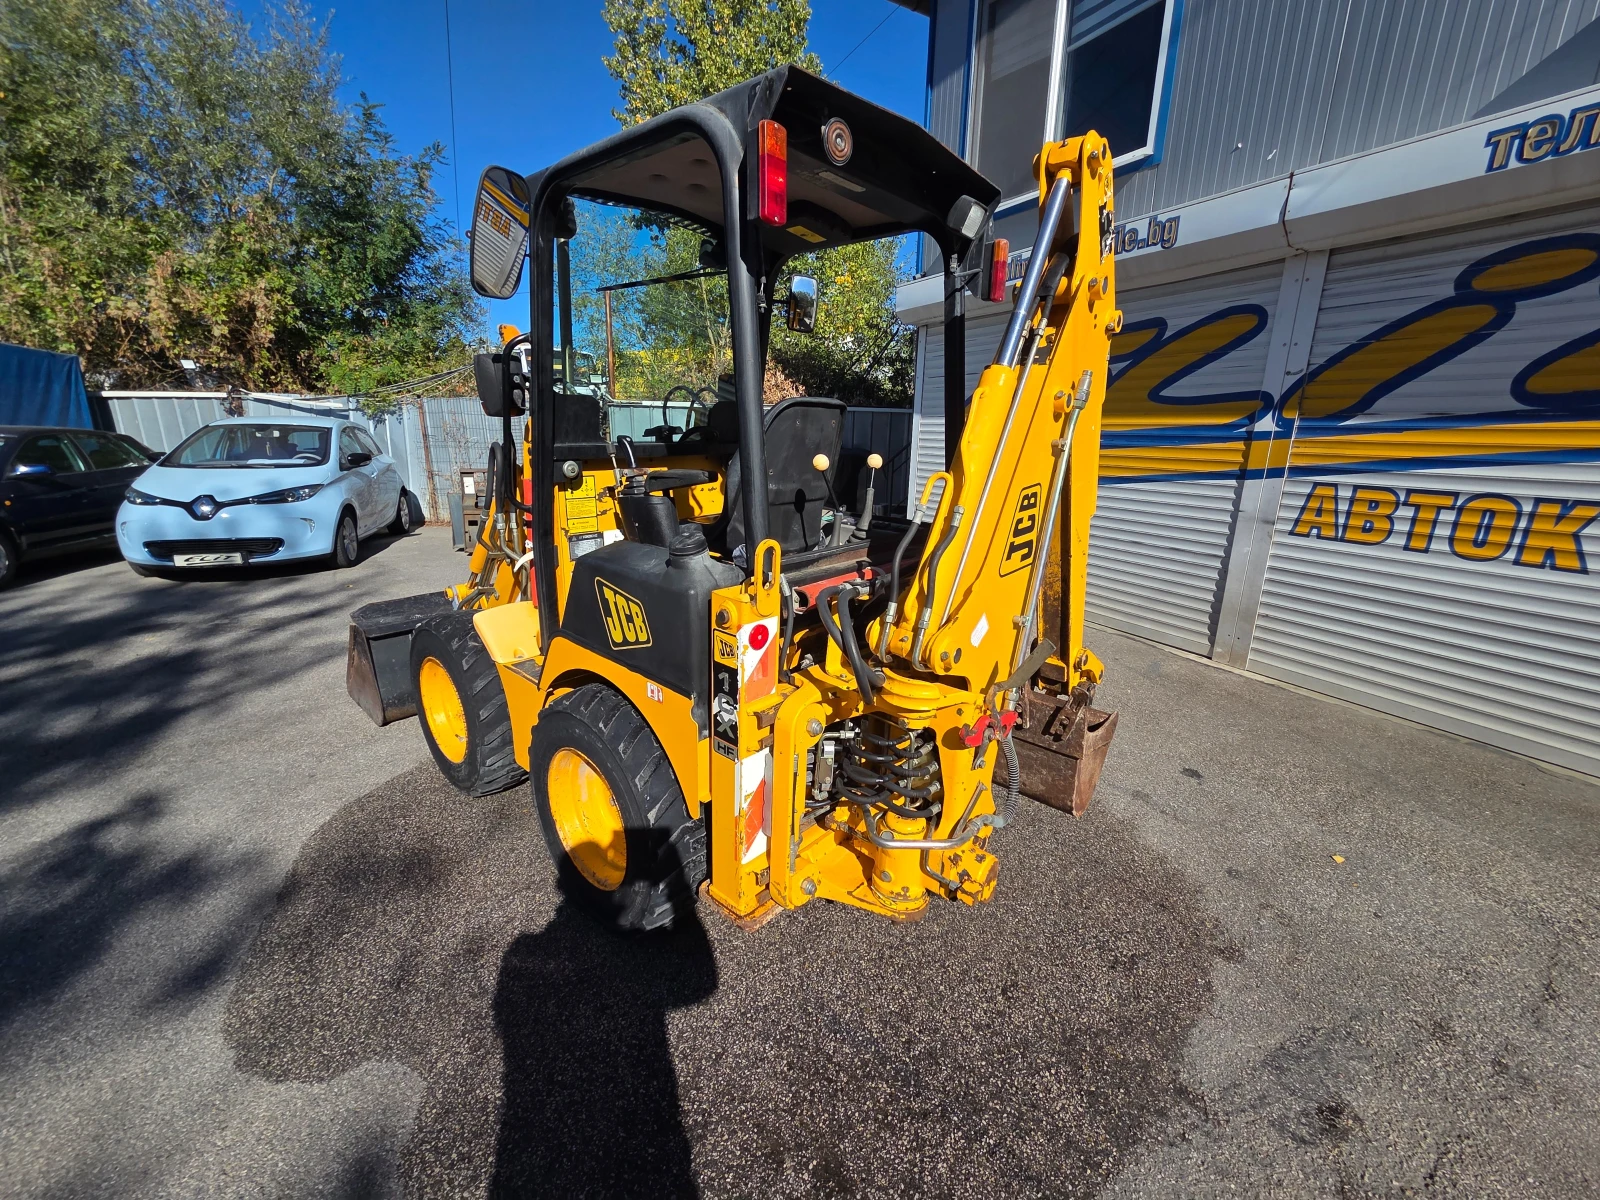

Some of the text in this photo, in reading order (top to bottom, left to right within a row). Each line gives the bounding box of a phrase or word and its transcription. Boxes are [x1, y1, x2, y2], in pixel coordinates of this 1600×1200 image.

[1114, 215, 1181, 256] le.bg
[1005, 491, 1038, 562] JCB
[603, 586, 648, 643] JCB
[719, 639, 735, 657] JCB
[717, 742, 735, 757] HF
